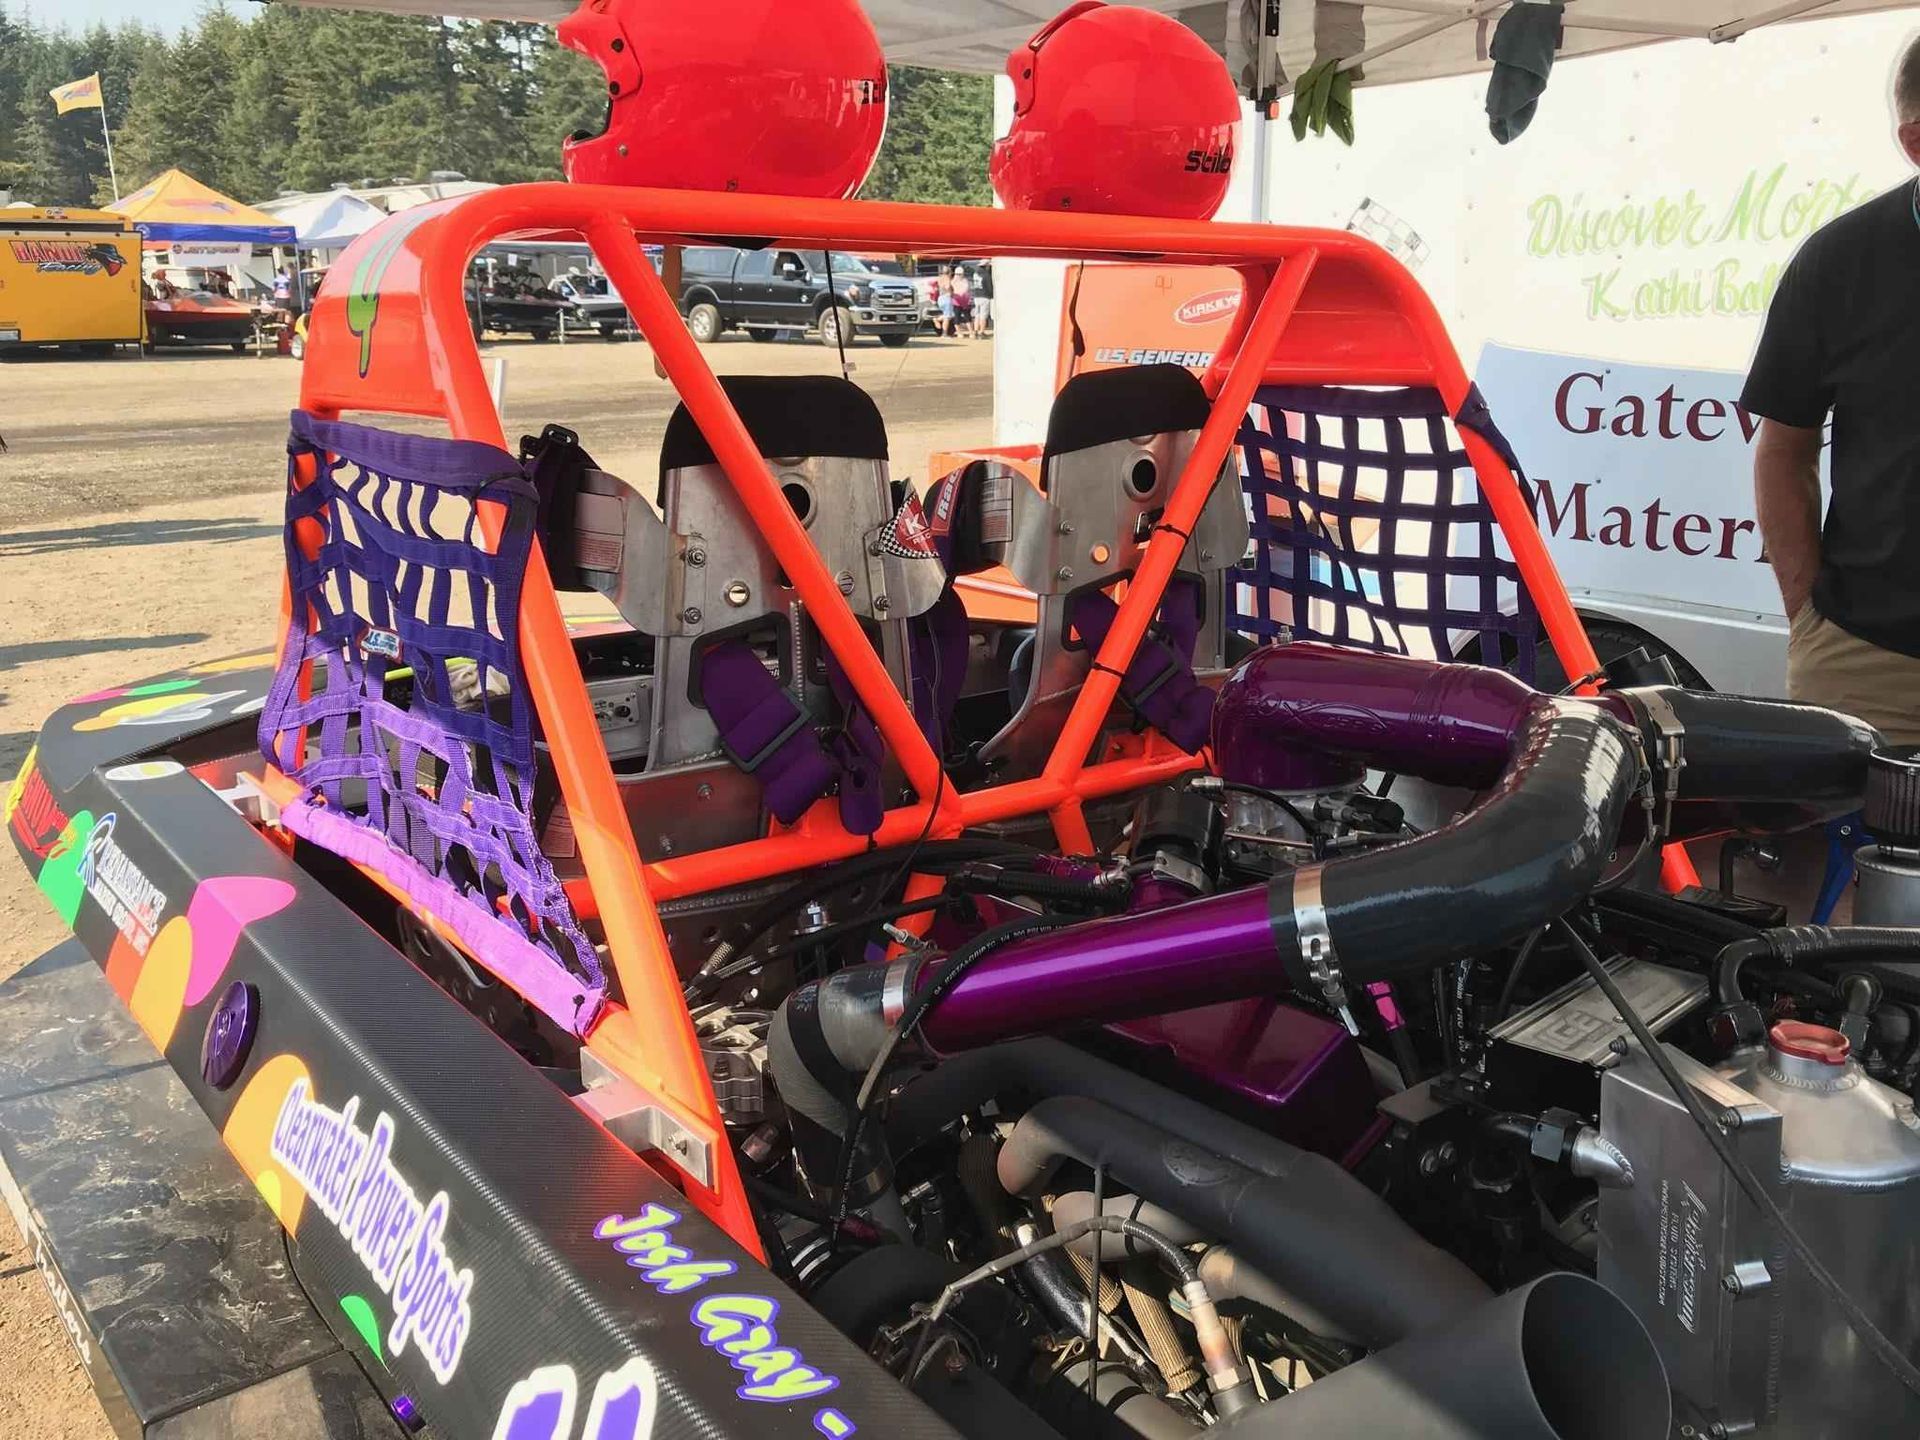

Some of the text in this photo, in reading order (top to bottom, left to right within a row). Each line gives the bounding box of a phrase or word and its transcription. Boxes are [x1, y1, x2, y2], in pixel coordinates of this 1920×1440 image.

[1527, 162, 1881, 256] Discover Mort
[1581, 257, 1780, 320] Kathi Bal
[1532, 478, 1770, 563] Mater
[271, 1083, 368, 1222] Clearwater
[389, 1191, 473, 1385] Sports
[594, 1203, 840, 1402] Josh Gray
